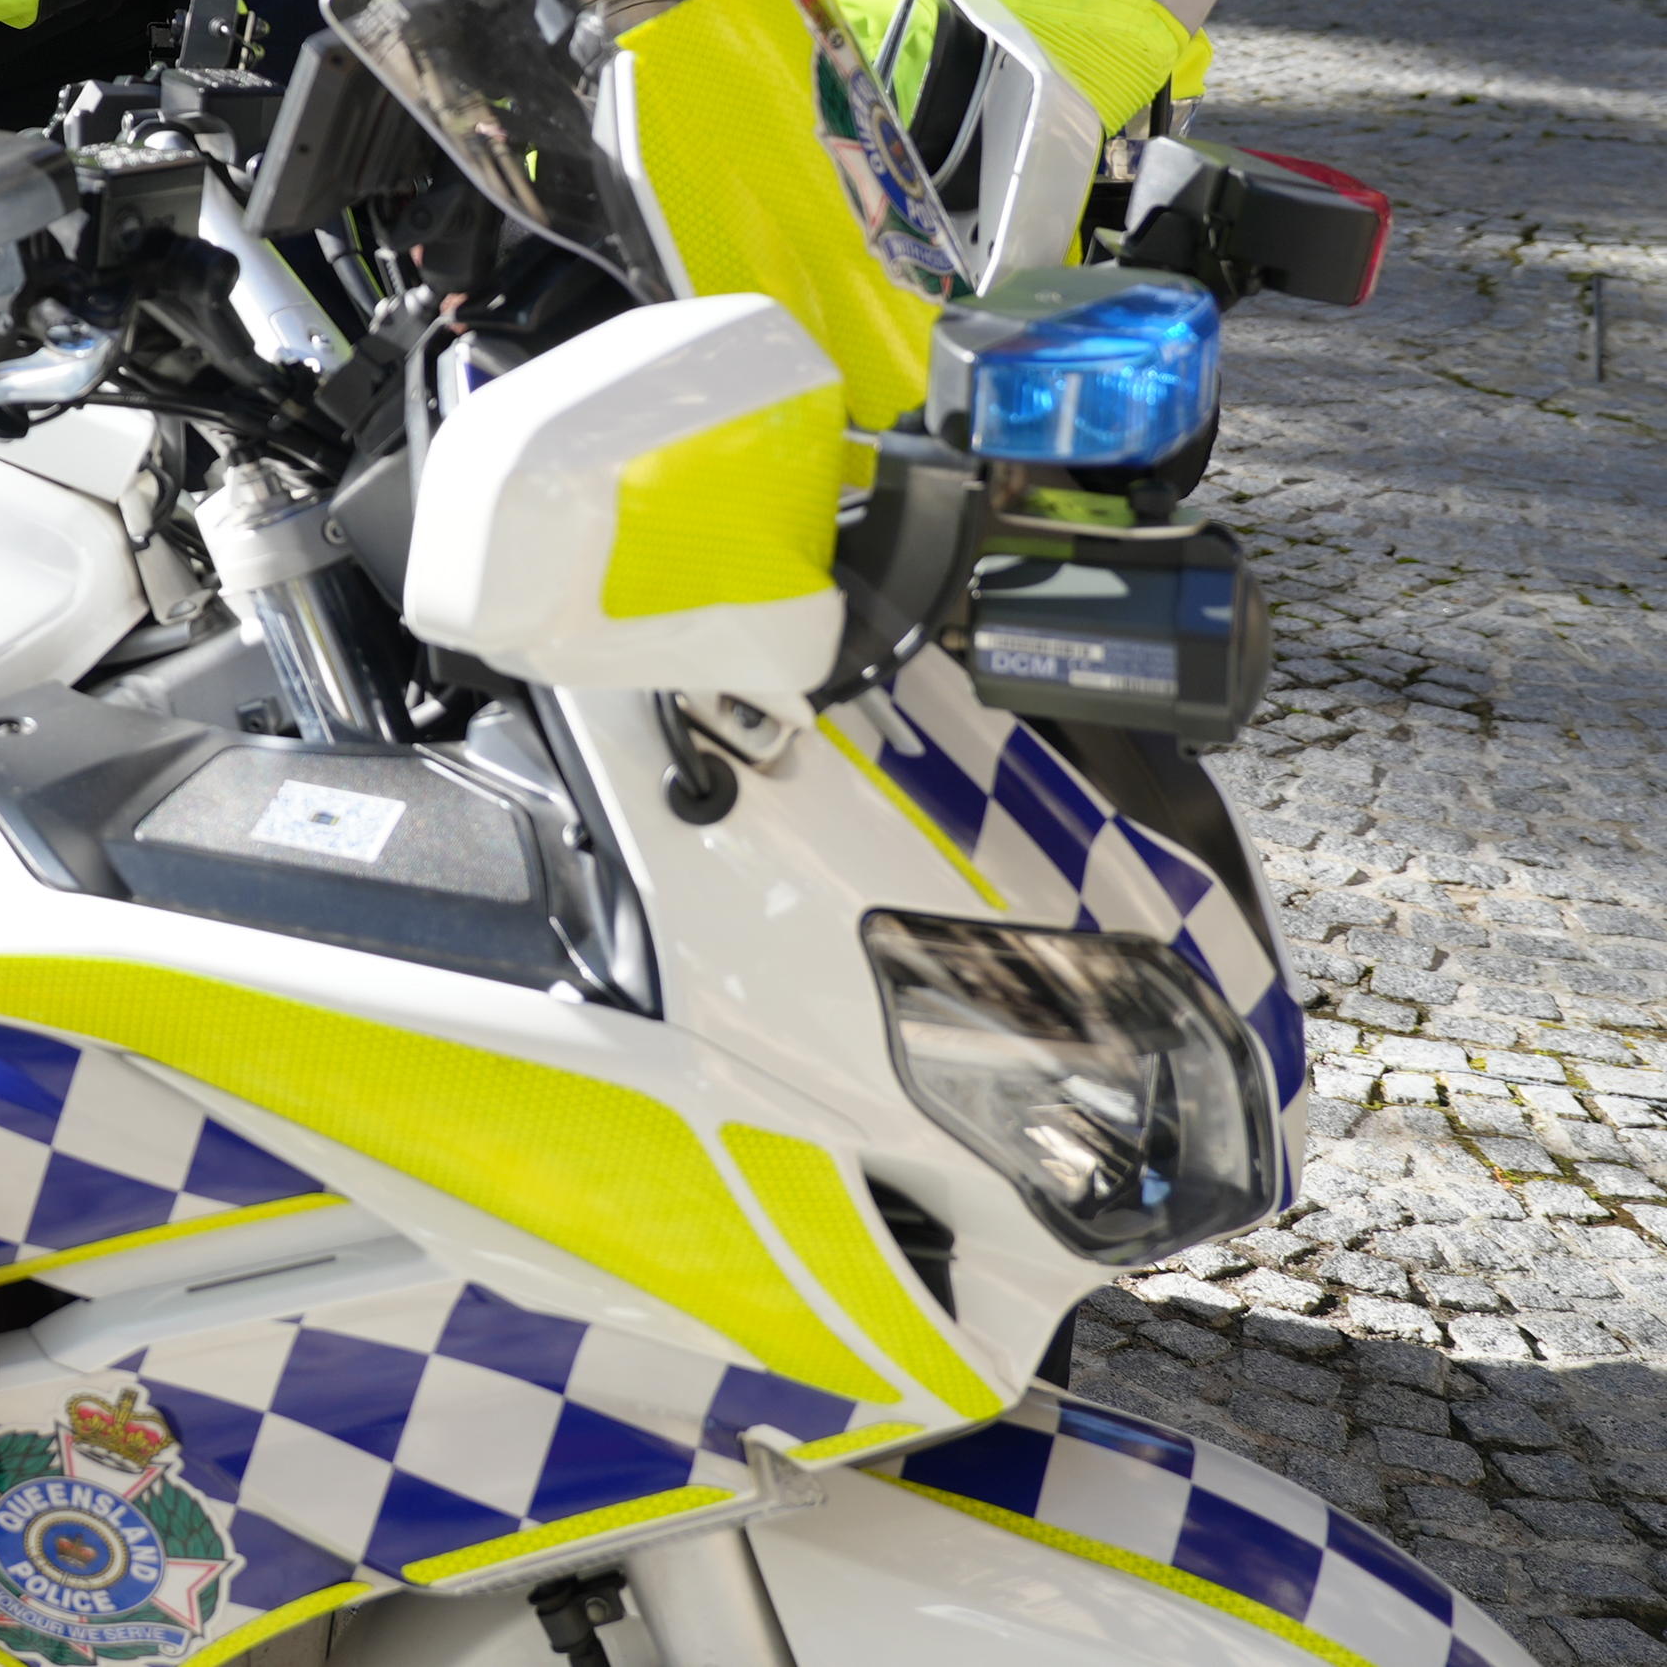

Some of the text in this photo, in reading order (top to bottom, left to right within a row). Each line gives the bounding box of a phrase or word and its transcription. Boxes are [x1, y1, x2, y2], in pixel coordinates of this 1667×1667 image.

[991, 649, 1058, 677] DCM
[7, 1559, 117, 1613] POLICE
[67, 1624, 101, 1640] WE
[102, 1625, 167, 1641] SERVE
